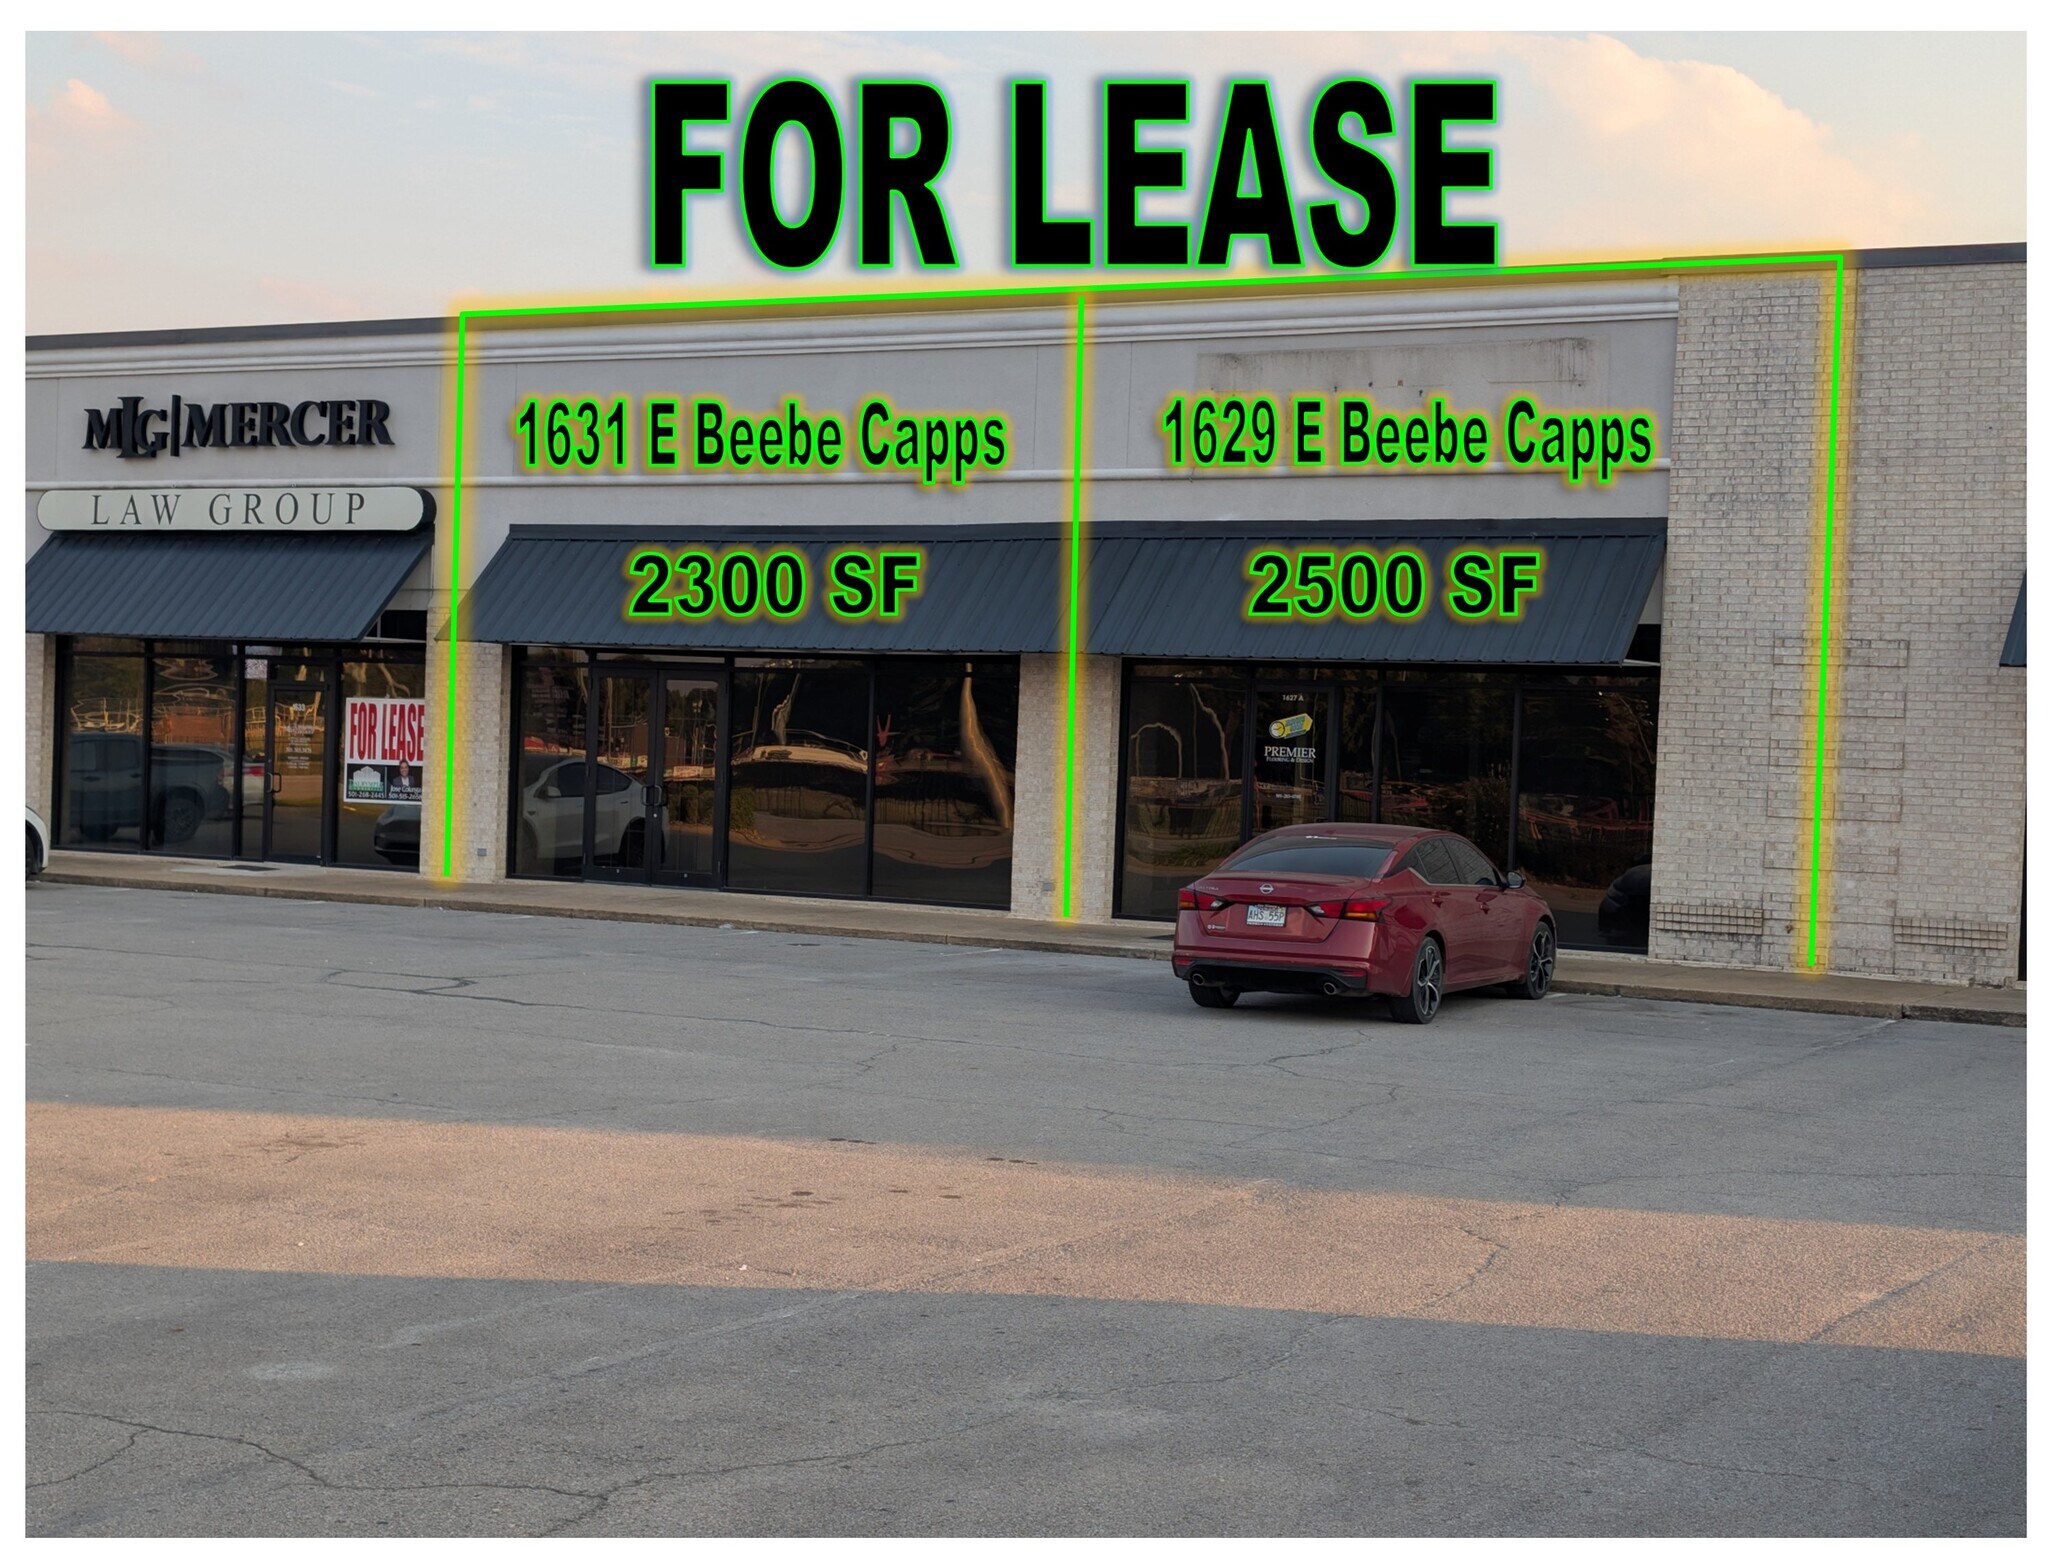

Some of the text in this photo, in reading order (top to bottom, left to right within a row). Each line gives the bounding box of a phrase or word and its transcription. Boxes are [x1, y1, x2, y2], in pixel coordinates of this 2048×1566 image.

[181, 399, 395, 448] MERCER
[90, 492, 366, 526] LAW GROUP
[1282, 694, 1298, 702] 1627
[349, 702, 425, 762] FOR LEASE
[1264, 745, 1316, 759] PREMIER
[1248, 909, 1285, 922] AHS 55P
